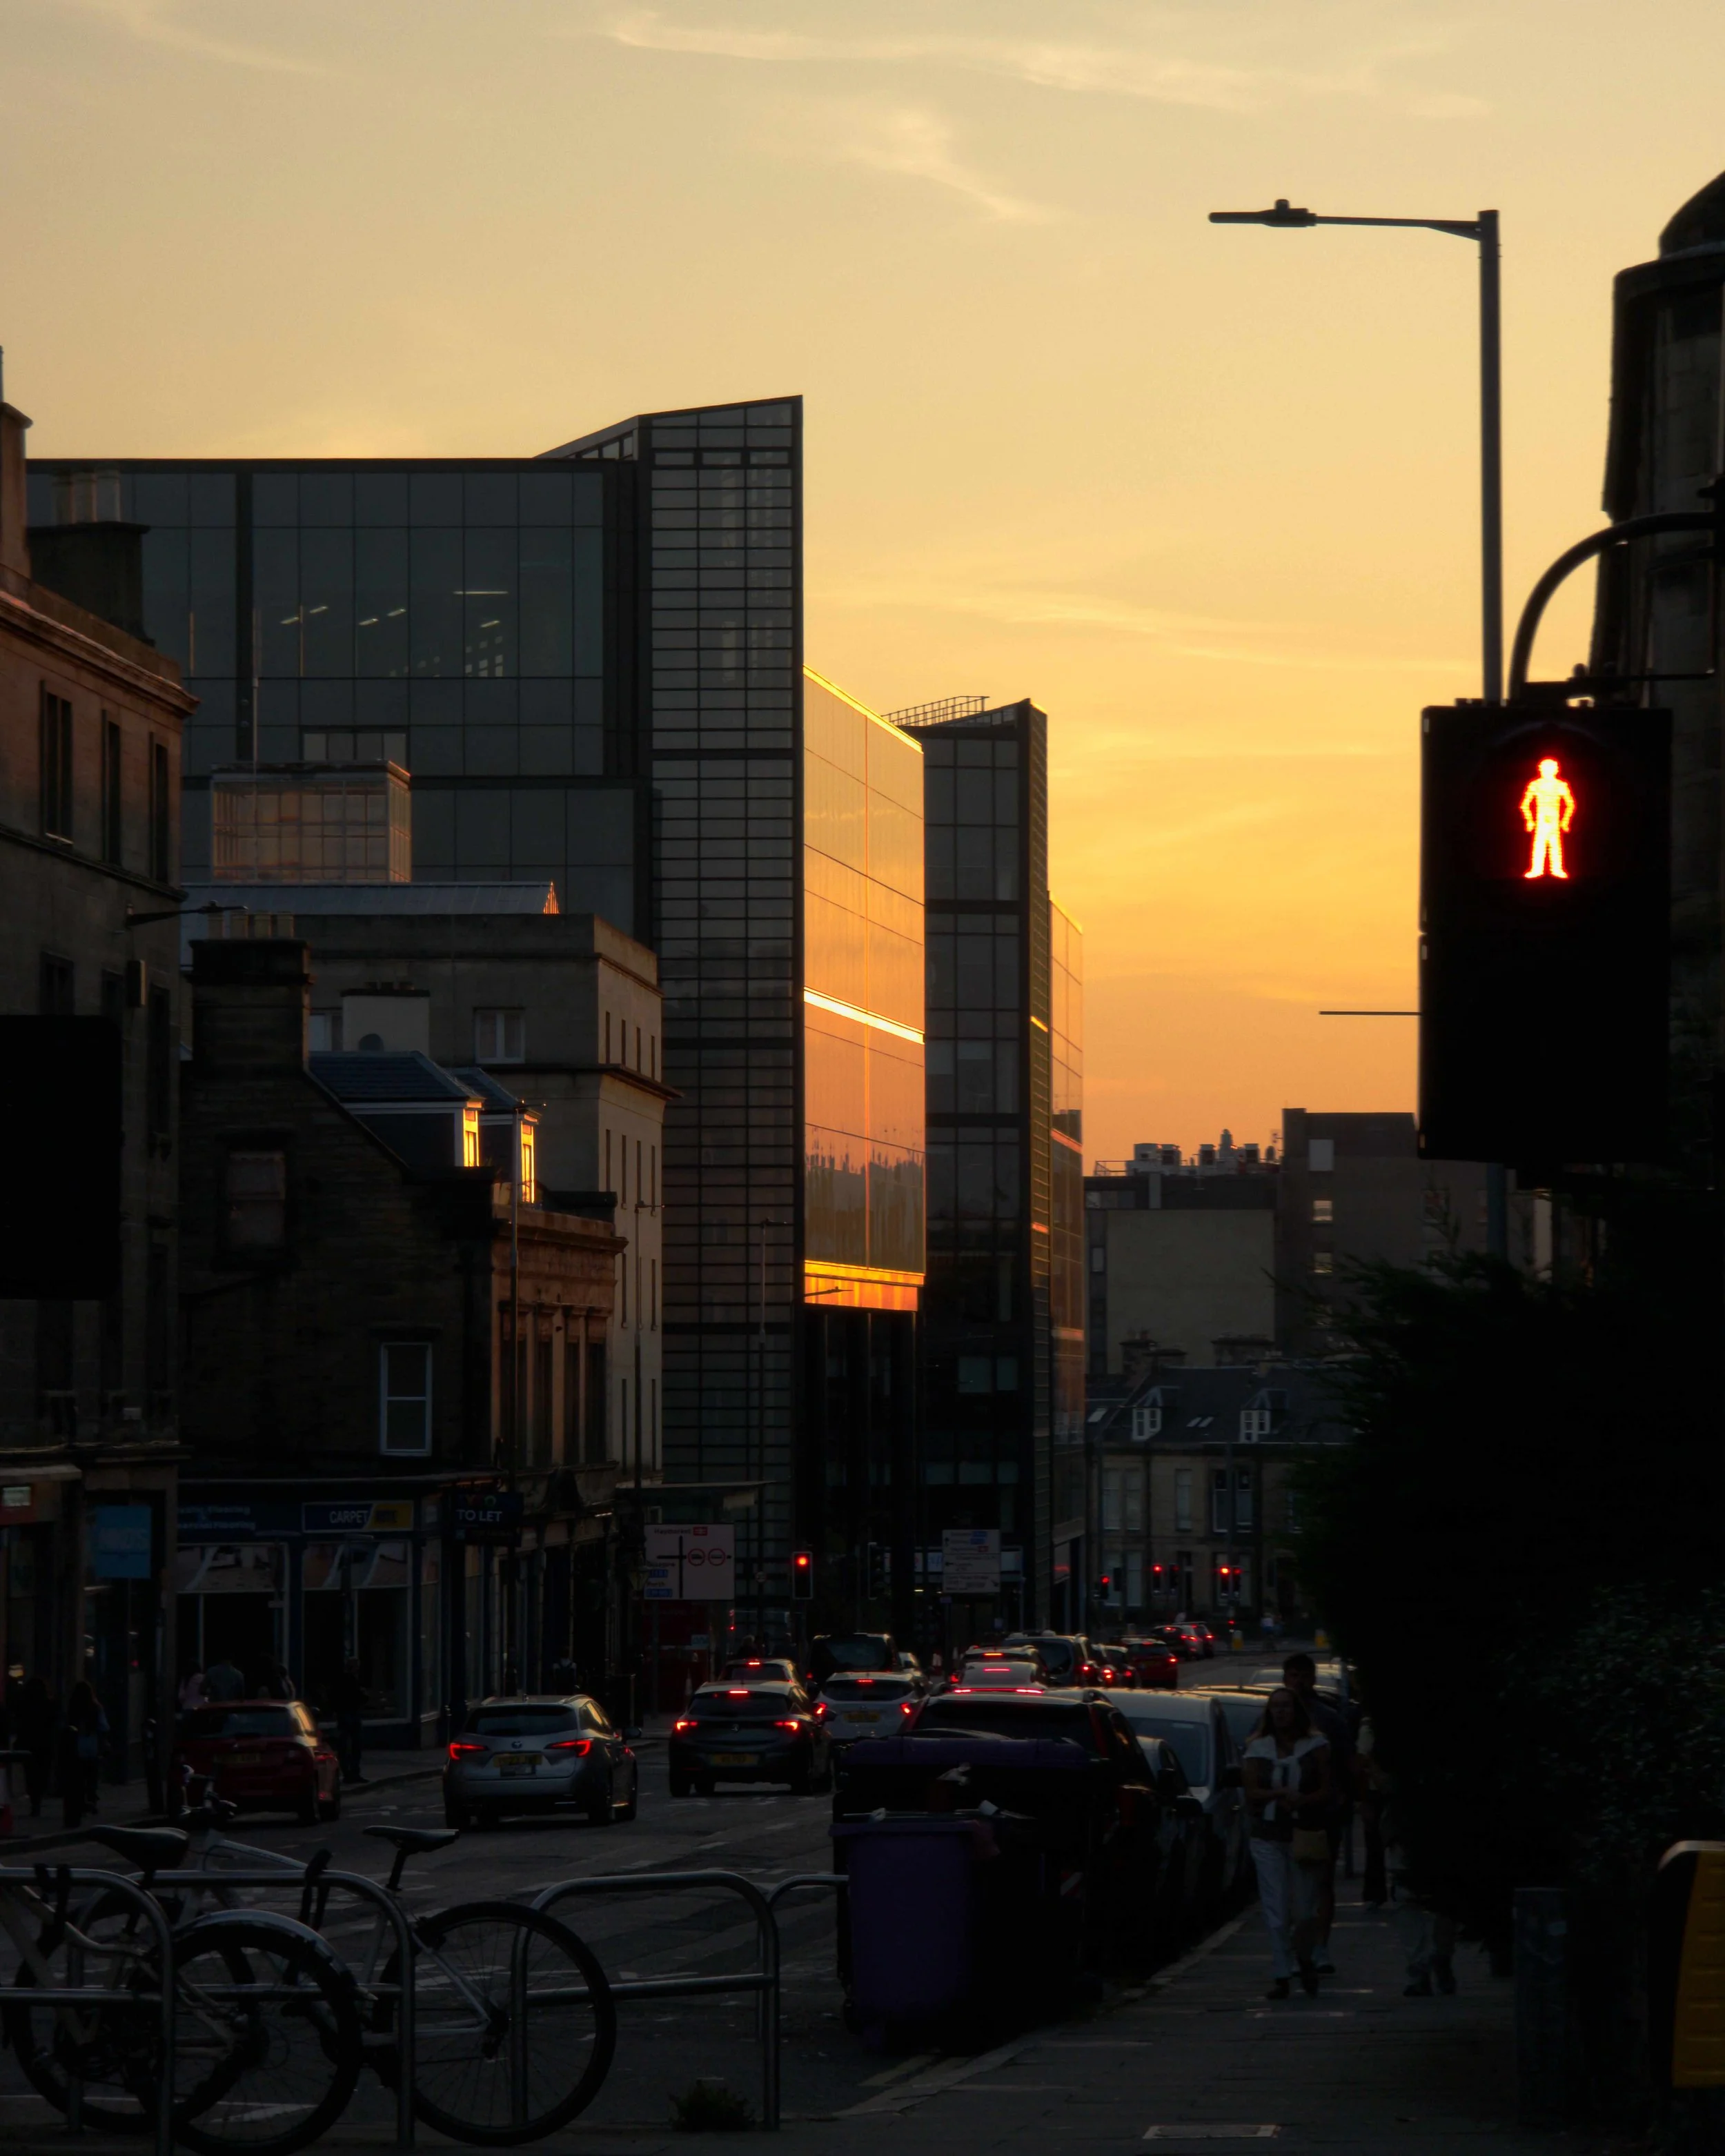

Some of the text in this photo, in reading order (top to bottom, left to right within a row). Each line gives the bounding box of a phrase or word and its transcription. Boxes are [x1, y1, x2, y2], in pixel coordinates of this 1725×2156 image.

[328, 1509, 369, 1524] CARPET
[455, 1509, 503, 1522] TO LET
